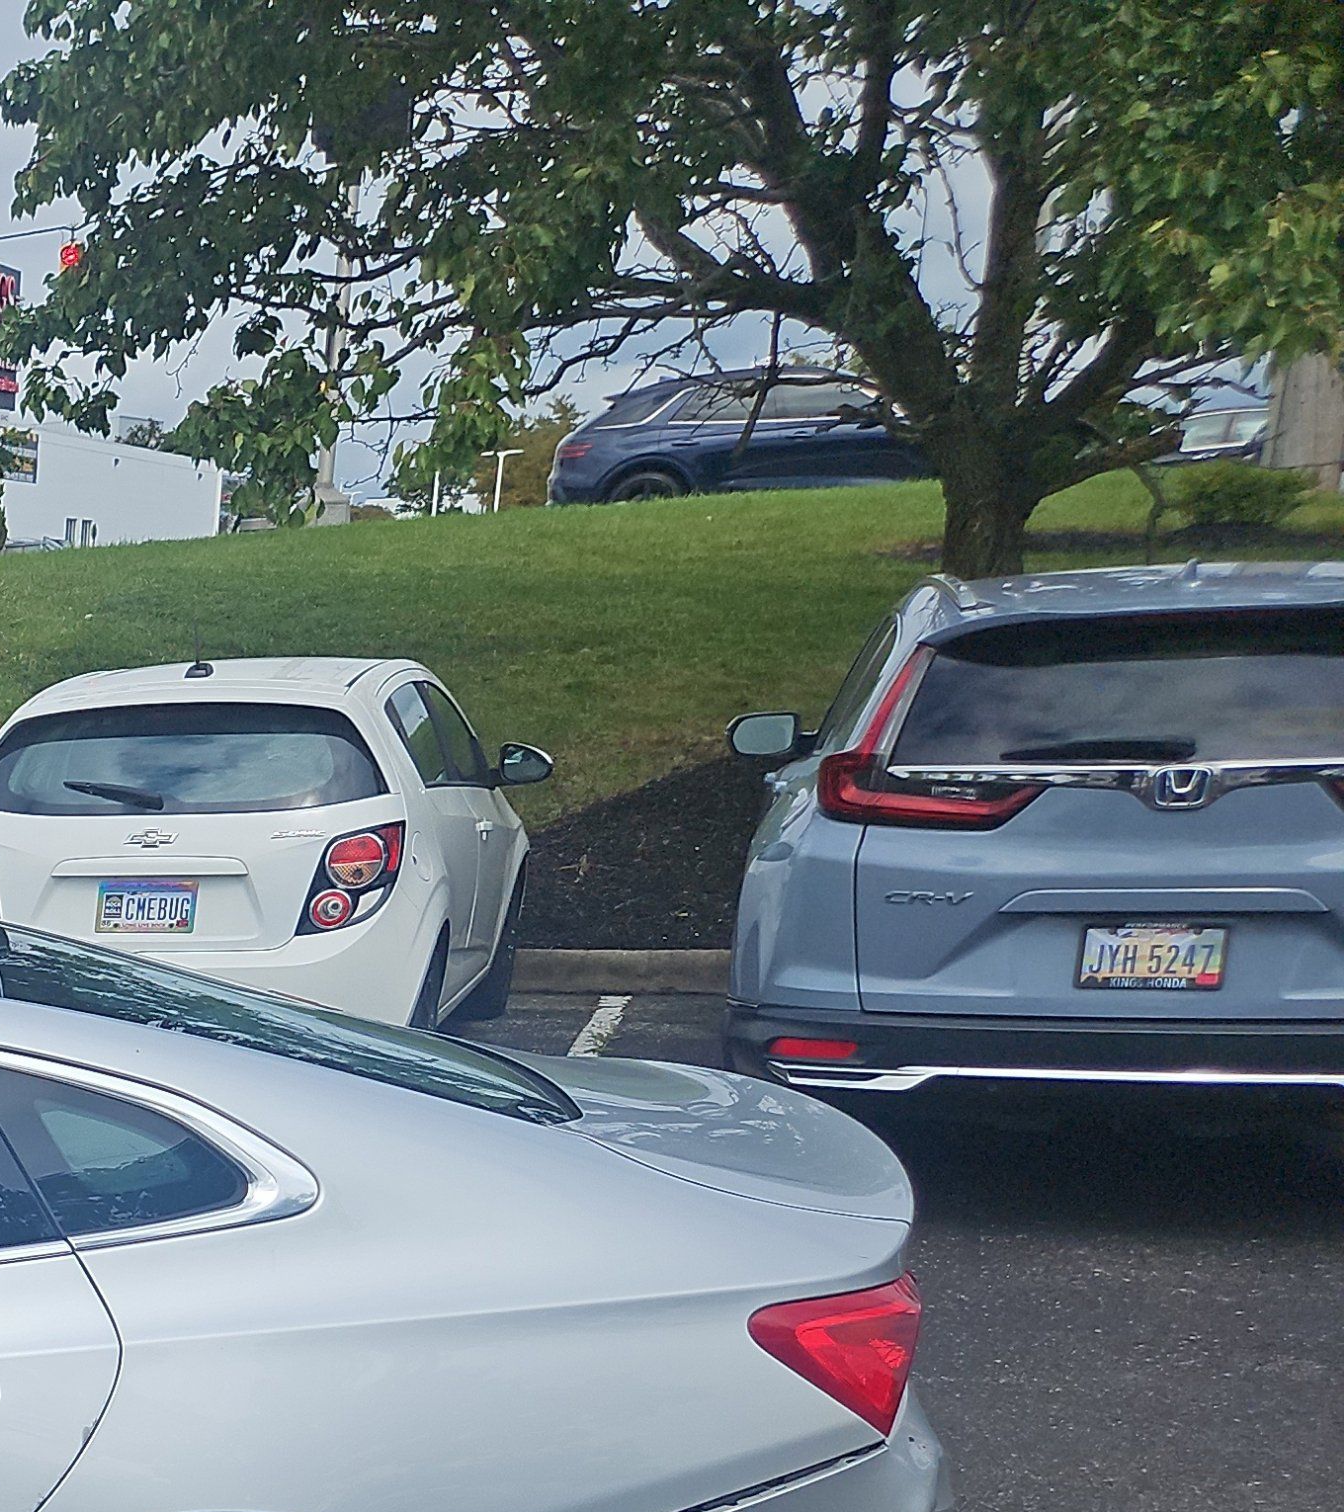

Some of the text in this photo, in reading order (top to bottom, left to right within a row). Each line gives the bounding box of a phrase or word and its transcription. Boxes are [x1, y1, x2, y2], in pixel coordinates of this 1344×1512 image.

[884, 890, 975, 906] CR-V
[125, 897, 191, 921] CMEBUG
[1088, 944, 1215, 975] JYH 5247
[1146, 977, 1187, 989] HONDA
